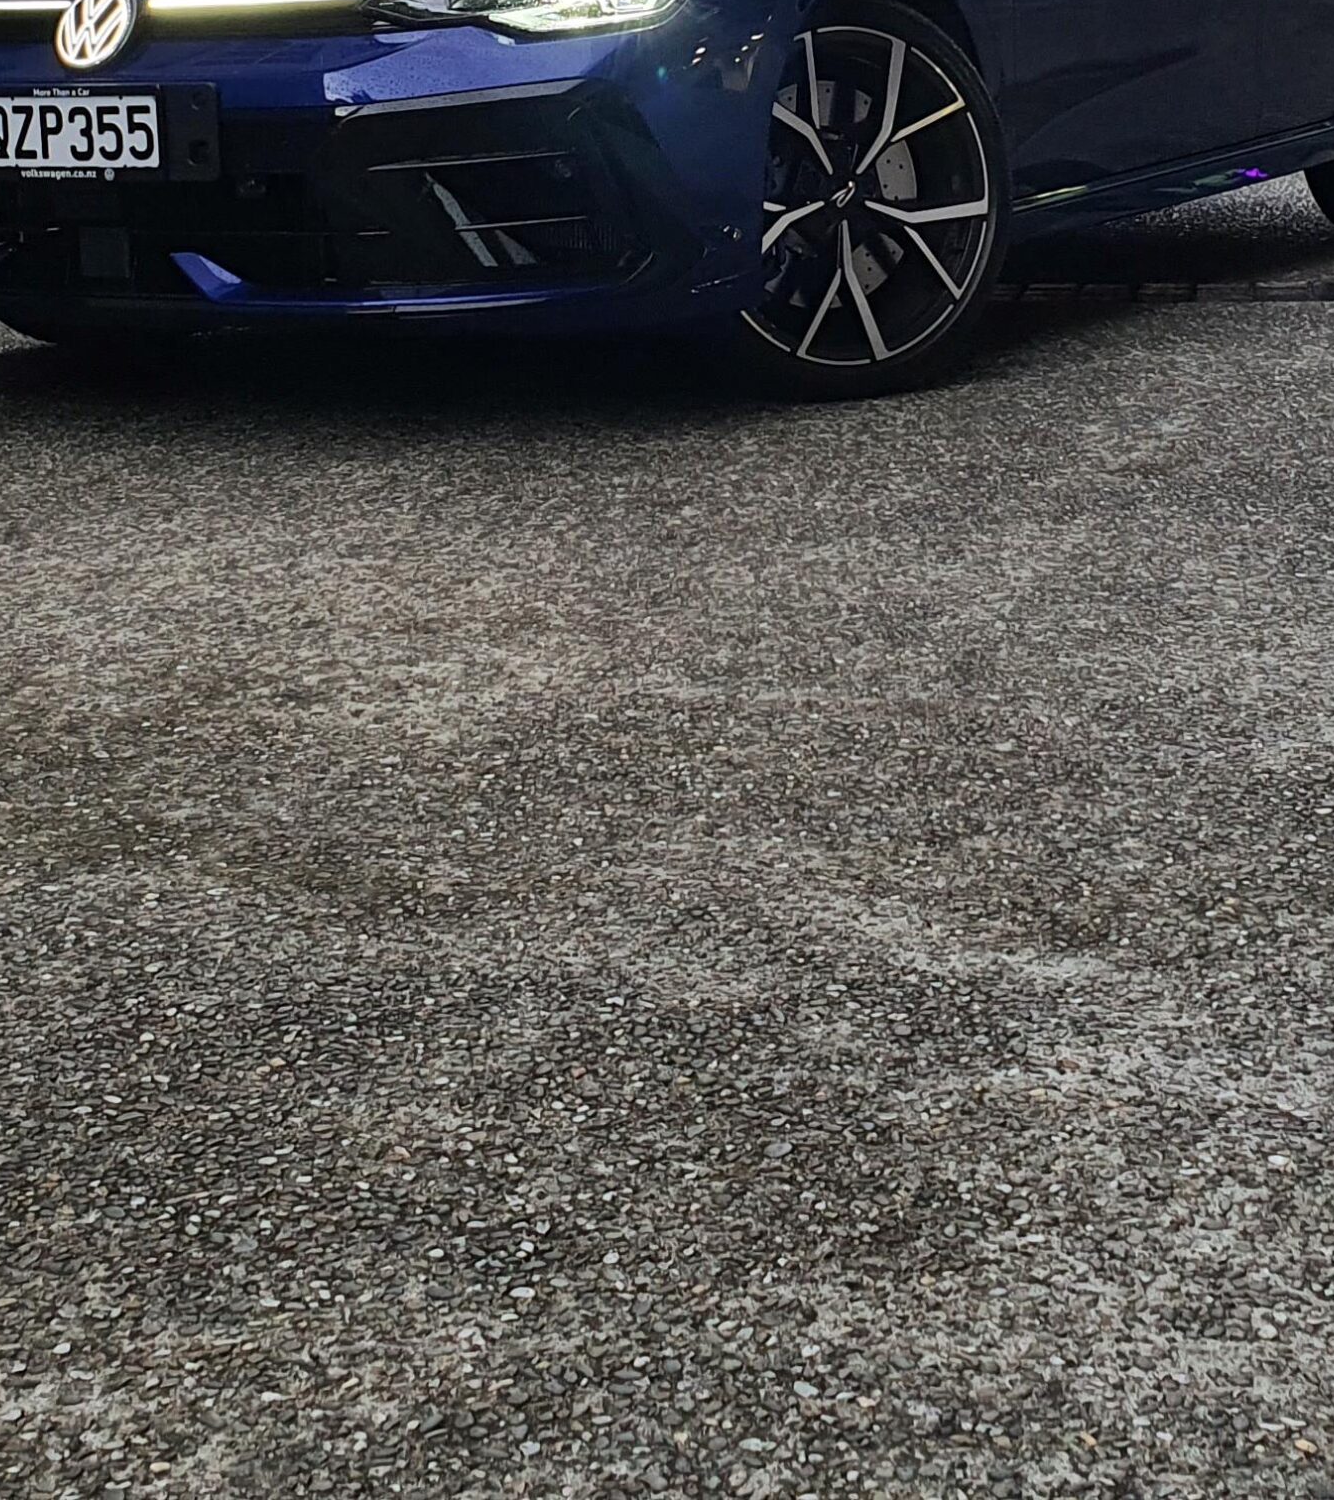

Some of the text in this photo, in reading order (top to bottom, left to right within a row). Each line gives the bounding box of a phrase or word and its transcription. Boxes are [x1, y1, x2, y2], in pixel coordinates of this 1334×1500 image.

[33, 88, 51, 96] More
[52, 88, 70, 96] Than
[77, 88, 90, 96] Car
[21, 168, 97, 180] volkswagen.co.nz
